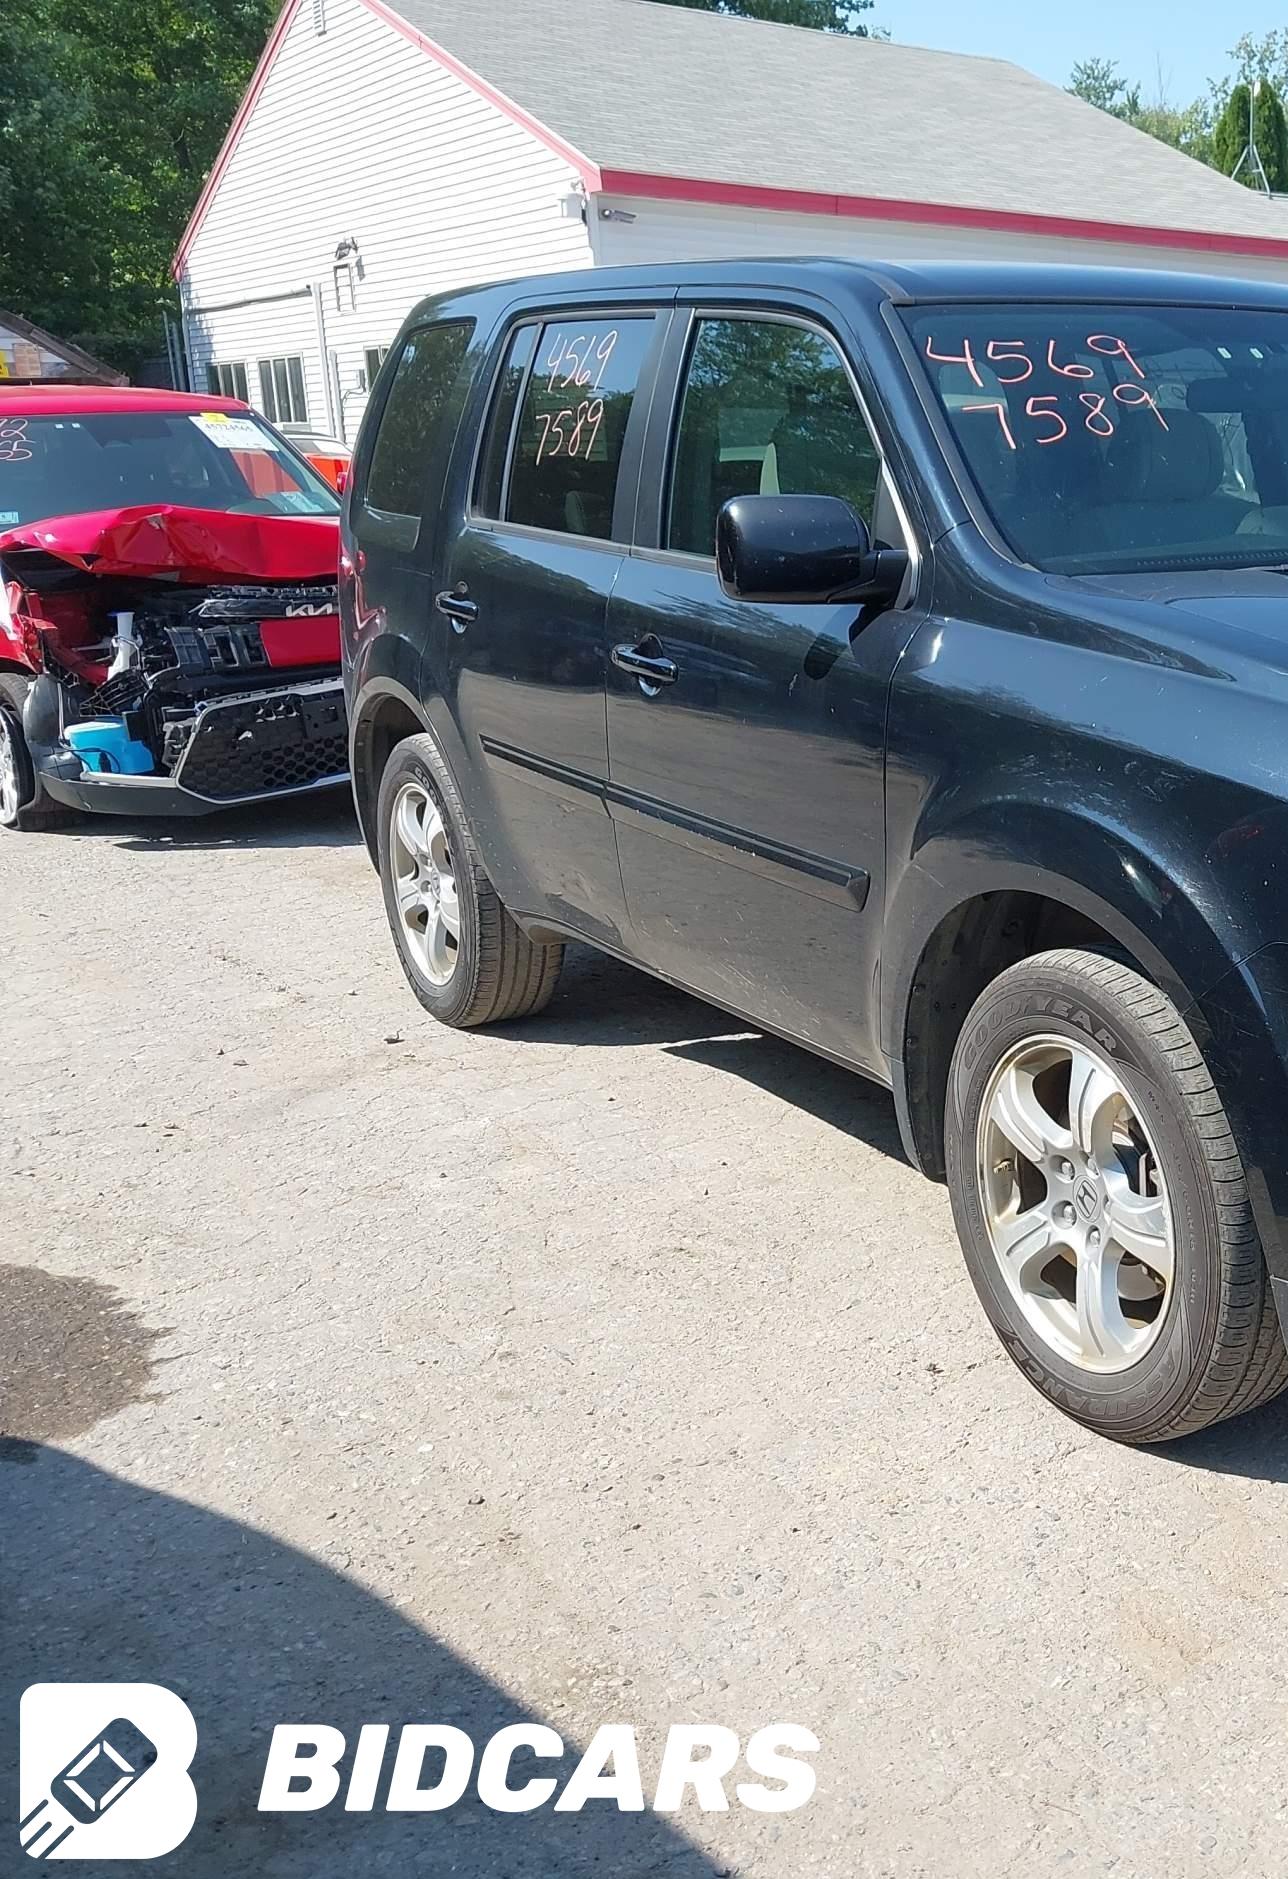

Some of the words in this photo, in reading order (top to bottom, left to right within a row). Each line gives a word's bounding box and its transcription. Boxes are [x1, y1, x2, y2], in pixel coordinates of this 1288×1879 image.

[547, 330, 618, 393] 4569
[926, 335, 1146, 388] 4569
[535, 398, 605, 467] 7589
[961, 383, 1170, 450] 7589
[963, 993, 1118, 1072] GOODYEAR
[1006, 1339, 1176, 1418] ASSURANCE
